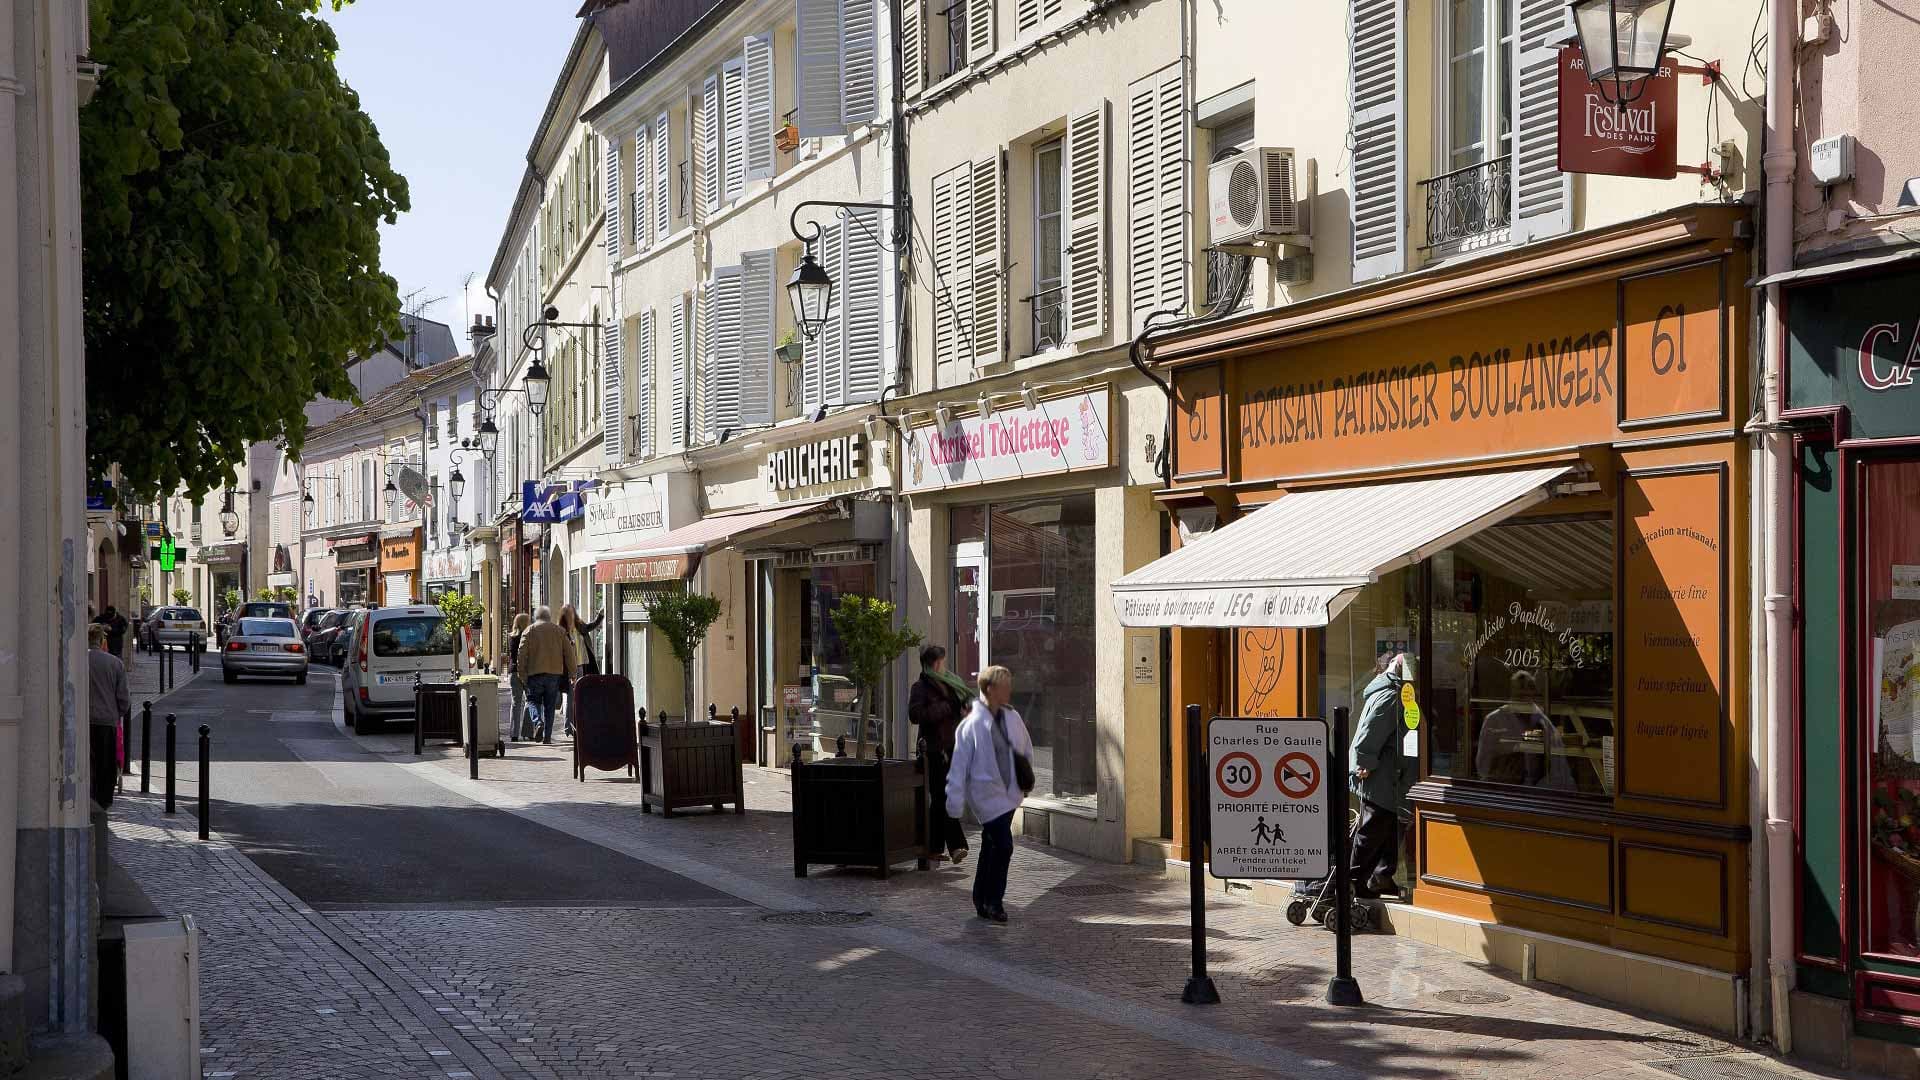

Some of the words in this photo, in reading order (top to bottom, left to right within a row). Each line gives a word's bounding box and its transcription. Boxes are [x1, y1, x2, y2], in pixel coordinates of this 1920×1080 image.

[1584, 93, 1657, 137] Festival
[1628, 134, 1656, 143] PAINS
[1651, 303, 1687, 376] 61
[1240, 379, 1324, 449] ARTISAN
[1332, 361, 1439, 438] PATISSIER
[1449, 330, 1613, 422] BOULANGER
[929, 423, 986, 466] Christel
[988, 415, 1070, 458] Toilettage
[767, 433, 859, 492] BOUCHERIE
[523, 501, 555, 518] AXA
[589, 502, 616, 526] Sybelle
[617, 510, 661, 531] CHAUSSEUR
[1676, 526, 1718, 552] artisanale
[1687, 584, 1708, 600] fine
[1125, 596, 1160, 618] Pâtisserie
[1163, 597, 1215, 621] boulangerie
[1224, 592, 1254, 617] JEG
[1463, 615, 1506, 666] Finaliste
[1509, 601, 1555, 634] Papilles
[1503, 648, 1541, 667] 2005
[1256, 725, 1279, 734] Rue
[1213, 736, 1259, 746] Charles
[1264, 737, 1280, 746] De
[1284, 737, 1322, 747] Gaulle
[1226, 765, 1252, 785] 30
[1217, 801, 1269, 813] PRIORITÉ
[1272, 801, 1320, 814] PIÉTONS
[1216, 847, 1247, 855] ARRÊT
[1250, 848, 1291, 856] GRATUIT
[1307, 848, 1322, 856] MN
[1232, 856, 1266, 864] Prendre
[1282, 857, 1307, 865] ticket
